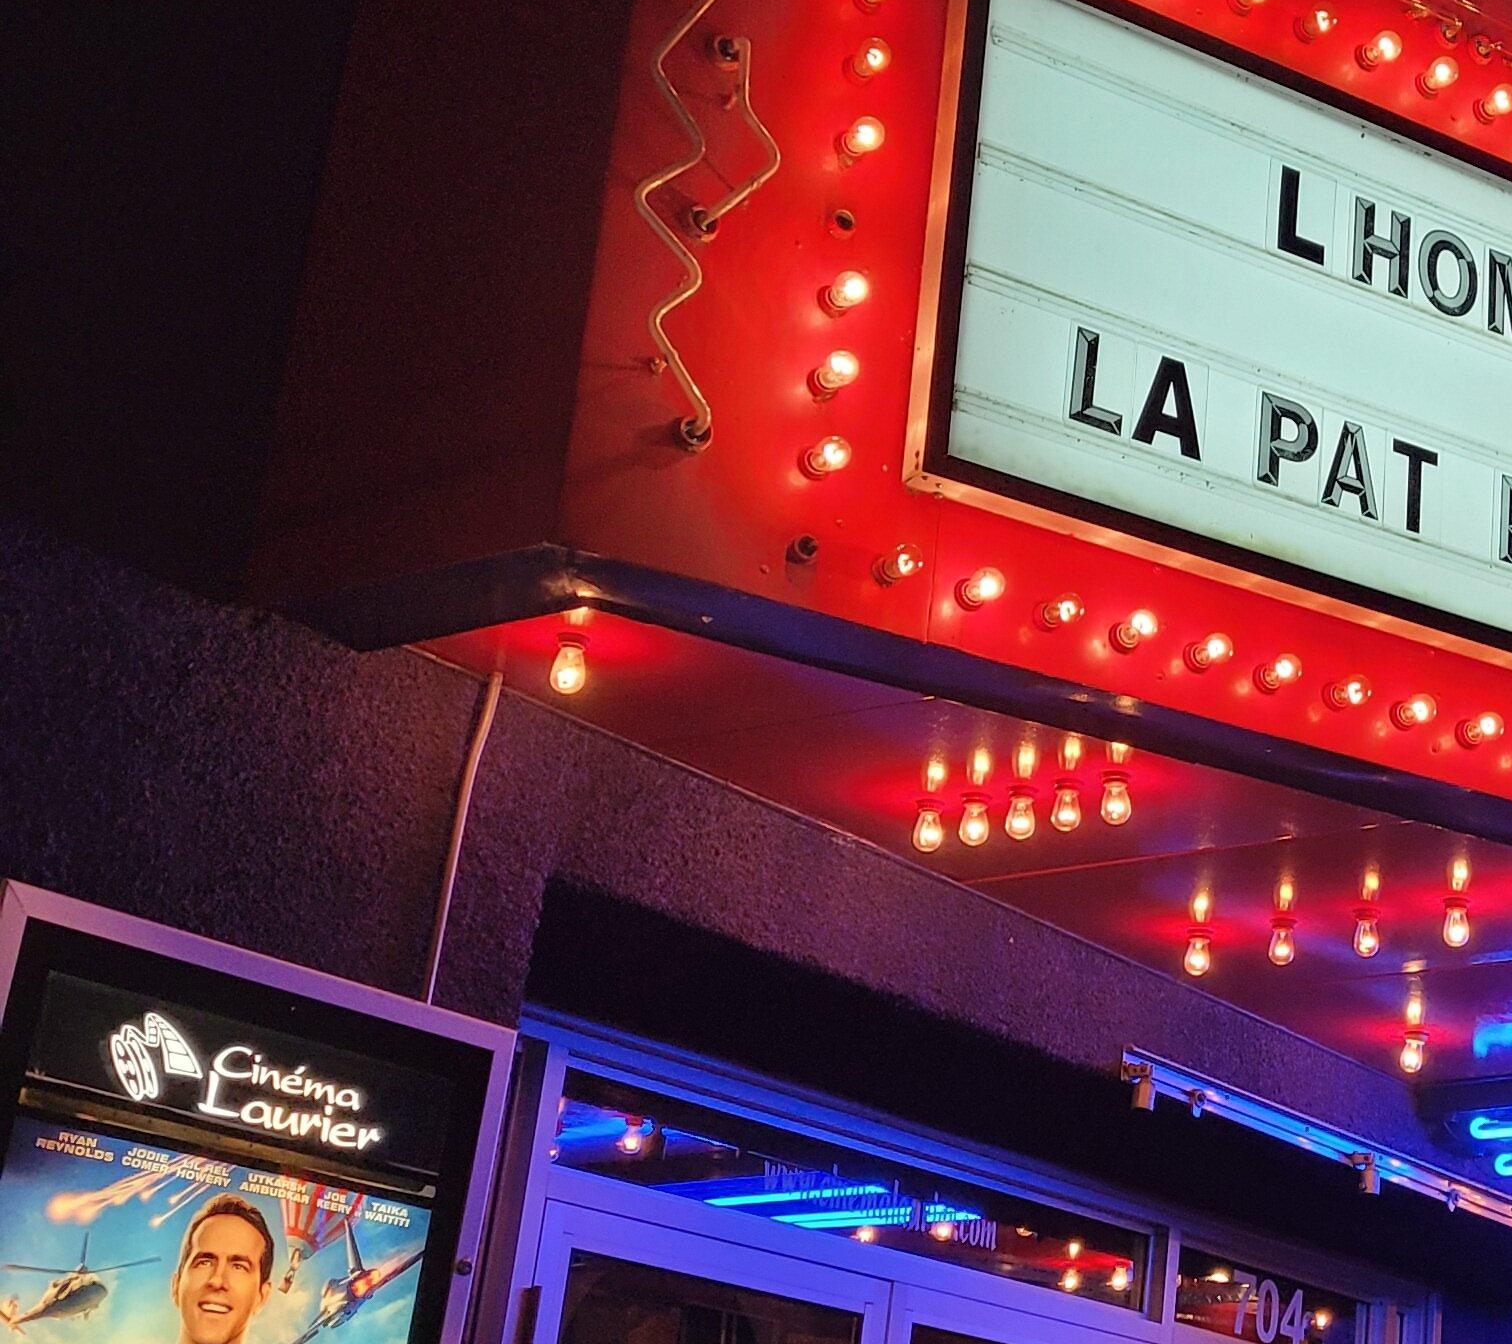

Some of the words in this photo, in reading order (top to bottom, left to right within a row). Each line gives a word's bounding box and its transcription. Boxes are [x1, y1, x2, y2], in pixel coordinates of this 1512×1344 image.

[1068, 326, 1202, 462] LA
[1256, 391, 1439, 534] PAT
[213, 1046, 361, 1111] Cinéma
[197, 1071, 383, 1151] Laurier
[59, 1131, 97, 1148] RYAN
[36, 1137, 114, 1162] REYNOLDS
[127, 1147, 169, 1164] JODIE
[122, 1157, 169, 1174] COMER
[175, 1168, 231, 1188] HOWERY
[324, 1191, 347, 1204] JOE
[316, 1199, 352, 1215] KEERY
[371, 1202, 408, 1218] TAIKA
[364, 1211, 410, 1228] WAITITI
